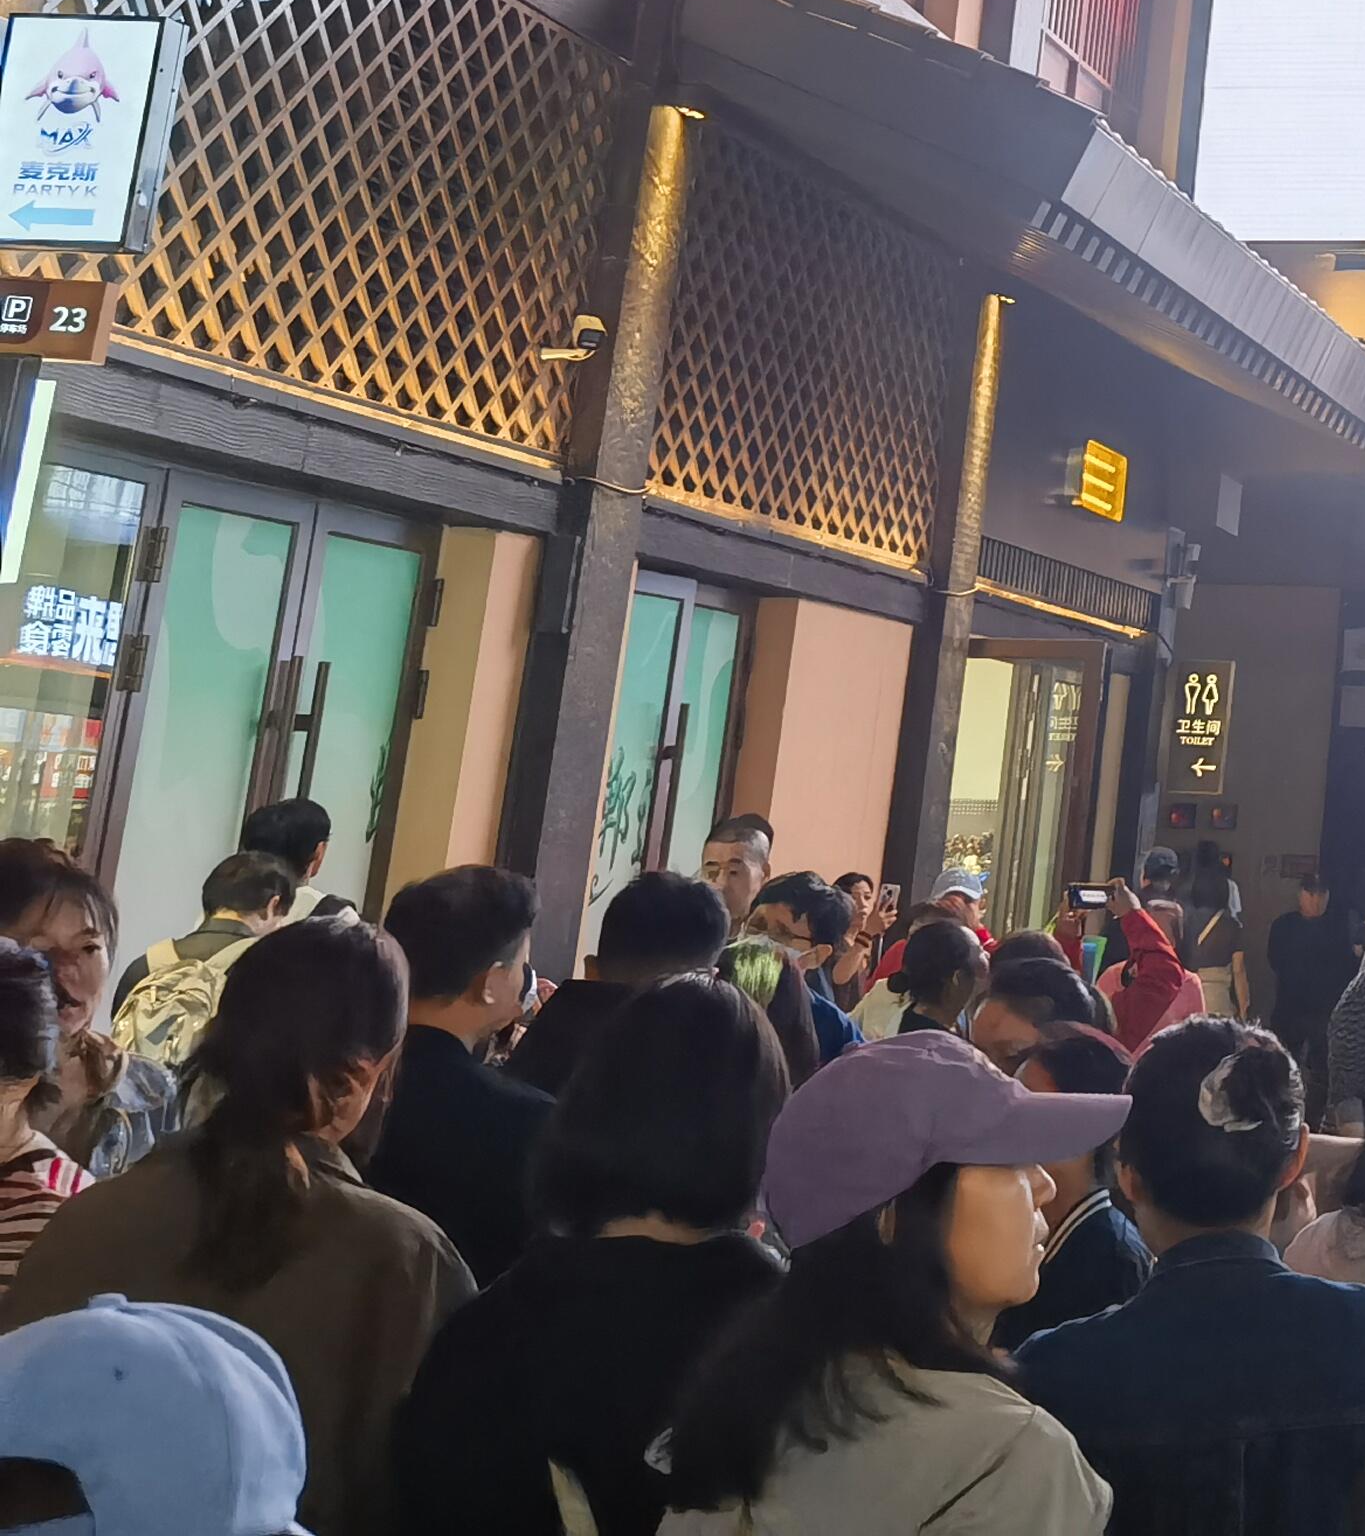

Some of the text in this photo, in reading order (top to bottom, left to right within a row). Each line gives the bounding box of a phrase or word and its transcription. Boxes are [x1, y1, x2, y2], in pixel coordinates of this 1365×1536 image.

[18, 162, 99, 182] 麦克斯
[13, 183, 97, 197] PARTY K
[49, 306, 87, 333] 23
[1176, 719, 1221, 736] 卫生间
[1179, 736, 1215, 746] TOILET
